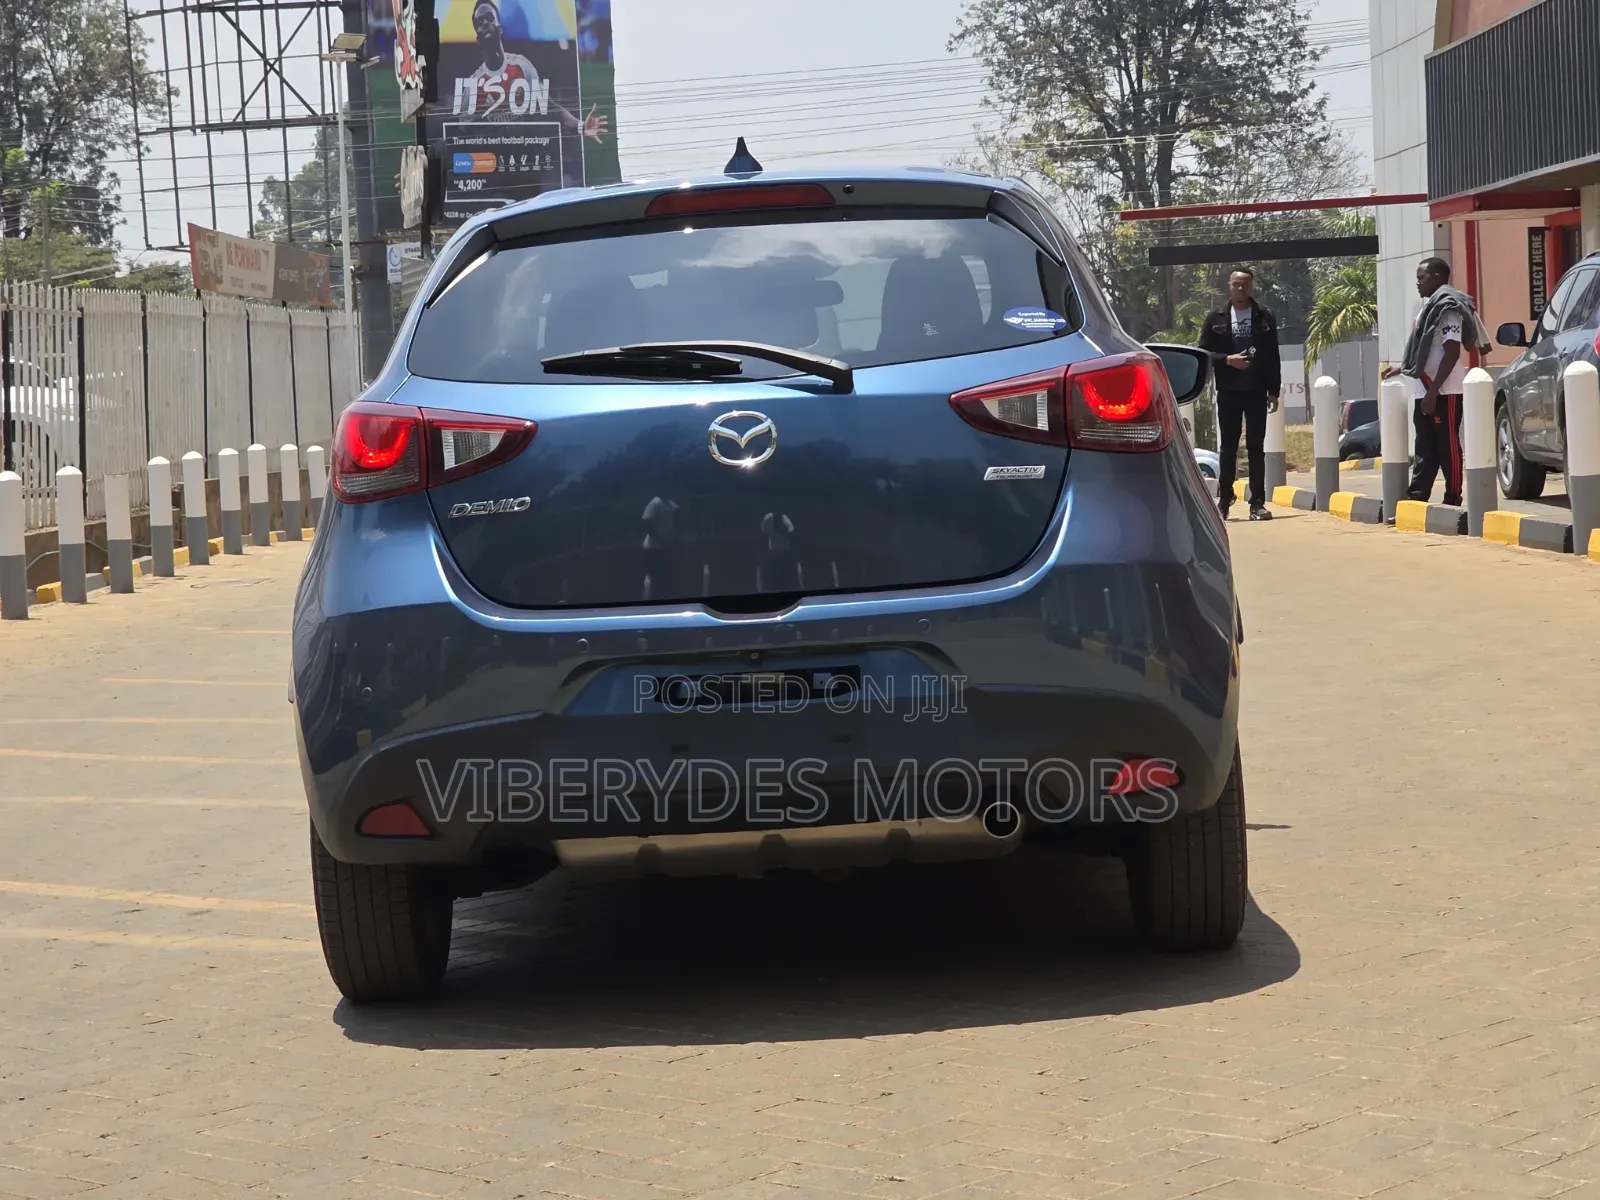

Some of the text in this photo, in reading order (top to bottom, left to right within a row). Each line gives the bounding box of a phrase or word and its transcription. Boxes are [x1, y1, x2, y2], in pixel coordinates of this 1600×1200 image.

[452, 72, 549, 119] IT'S ON
[453, 136, 465, 145] The
[487, 136, 501, 145] best
[501, 136, 524, 145] football
[524, 136, 550, 147] package
[1531, 234, 1545, 313] COLLECT HERE
[991, 466, 1040, 474] SKYACTIV
[448, 496, 531, 518] DEMIO
